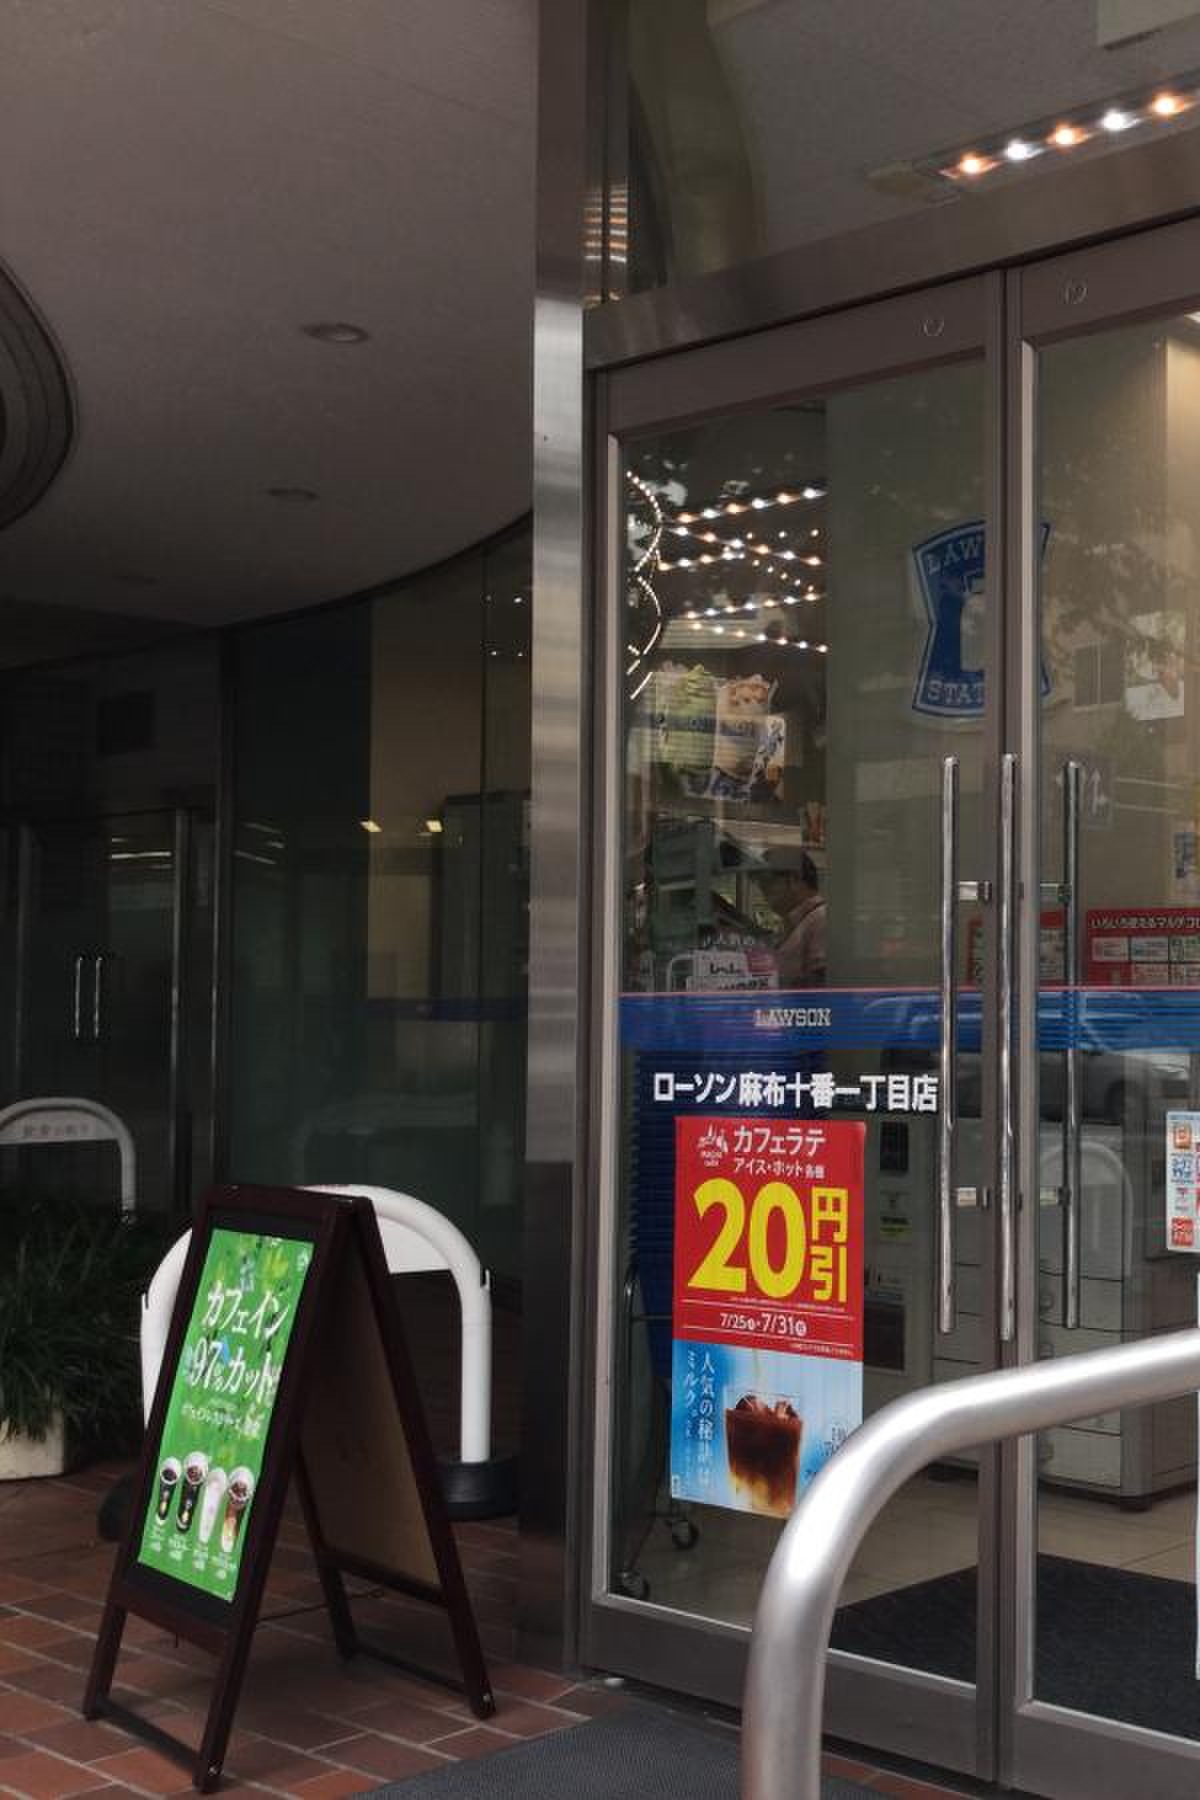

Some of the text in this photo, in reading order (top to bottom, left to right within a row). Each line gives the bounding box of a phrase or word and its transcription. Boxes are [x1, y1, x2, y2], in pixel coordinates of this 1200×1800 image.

[755, 1008, 832, 1028] LAWSON
[653, 1072, 939, 1112] ローソン麻布十番一丁目店
[733, 1125, 827, 1157] カフェラテ
